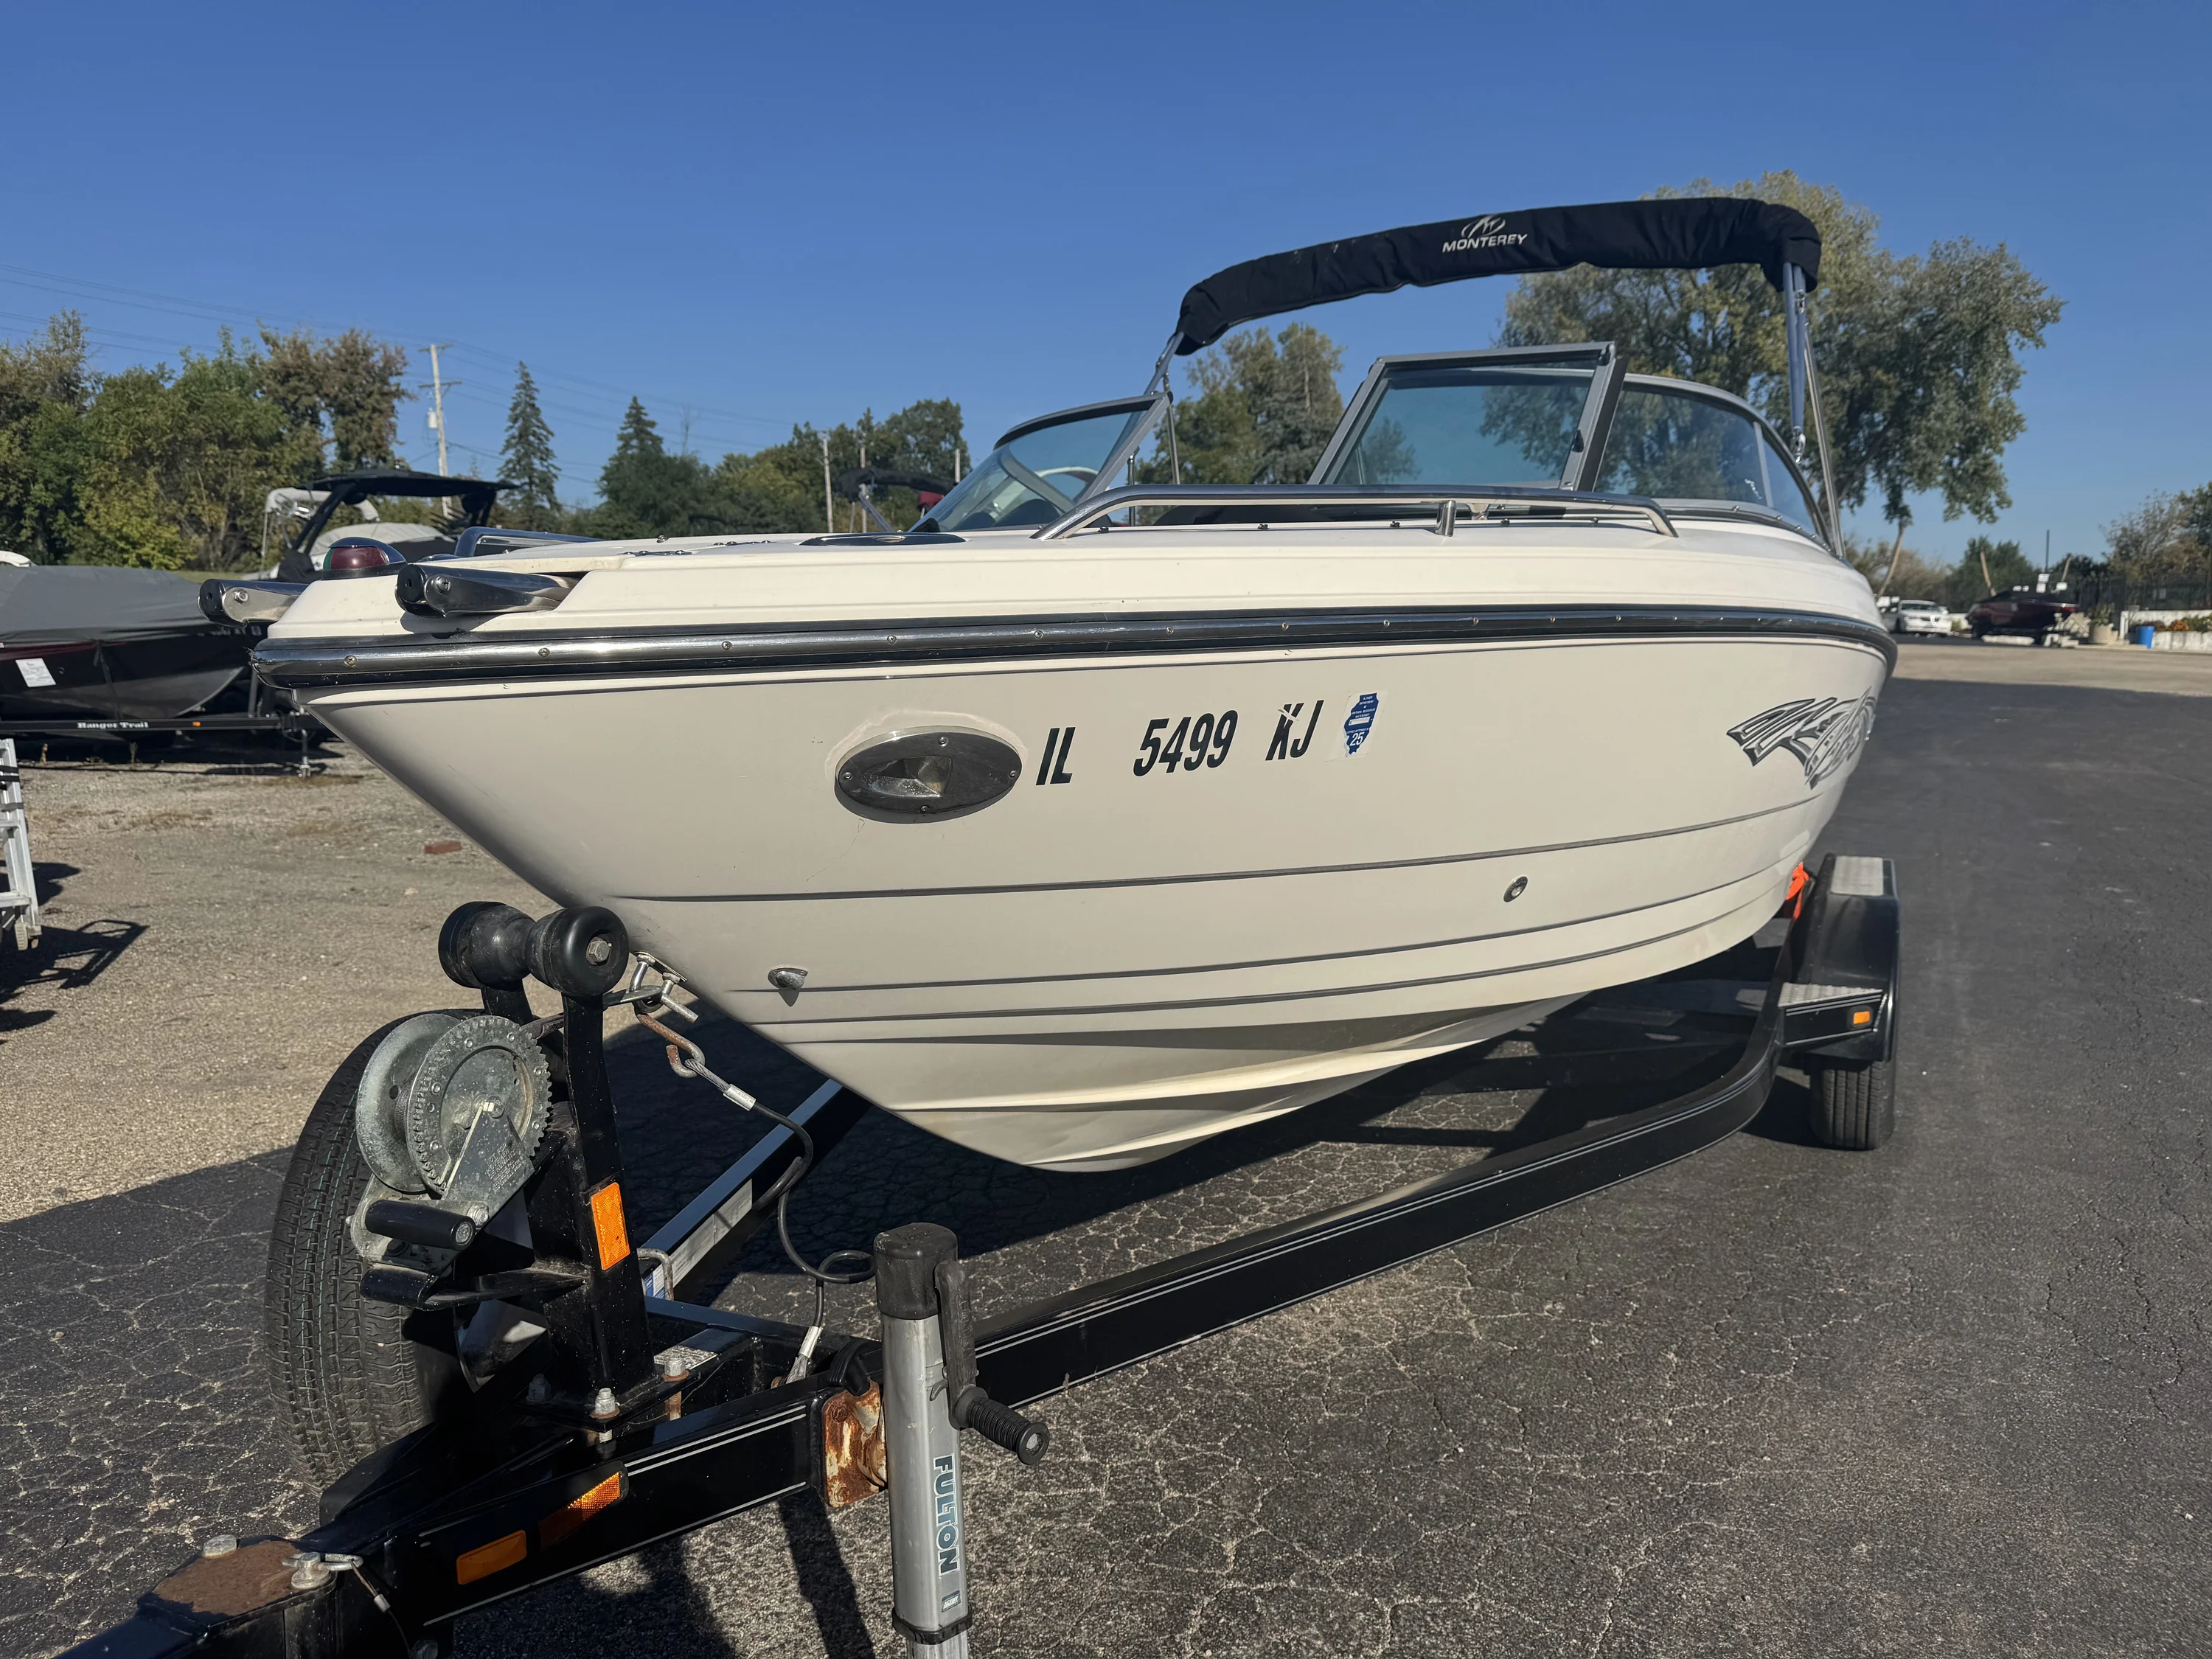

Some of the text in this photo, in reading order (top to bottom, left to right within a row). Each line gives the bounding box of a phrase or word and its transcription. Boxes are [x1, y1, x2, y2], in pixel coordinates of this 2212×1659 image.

[1442, 234, 1528, 253] MONTEREY
[77, 722, 118, 730] Ranger
[1036, 700, 1324, 785] IL 5499 KJ
[1350, 732, 1365, 746] 25
[934, 1454, 959, 1576] FULTON
